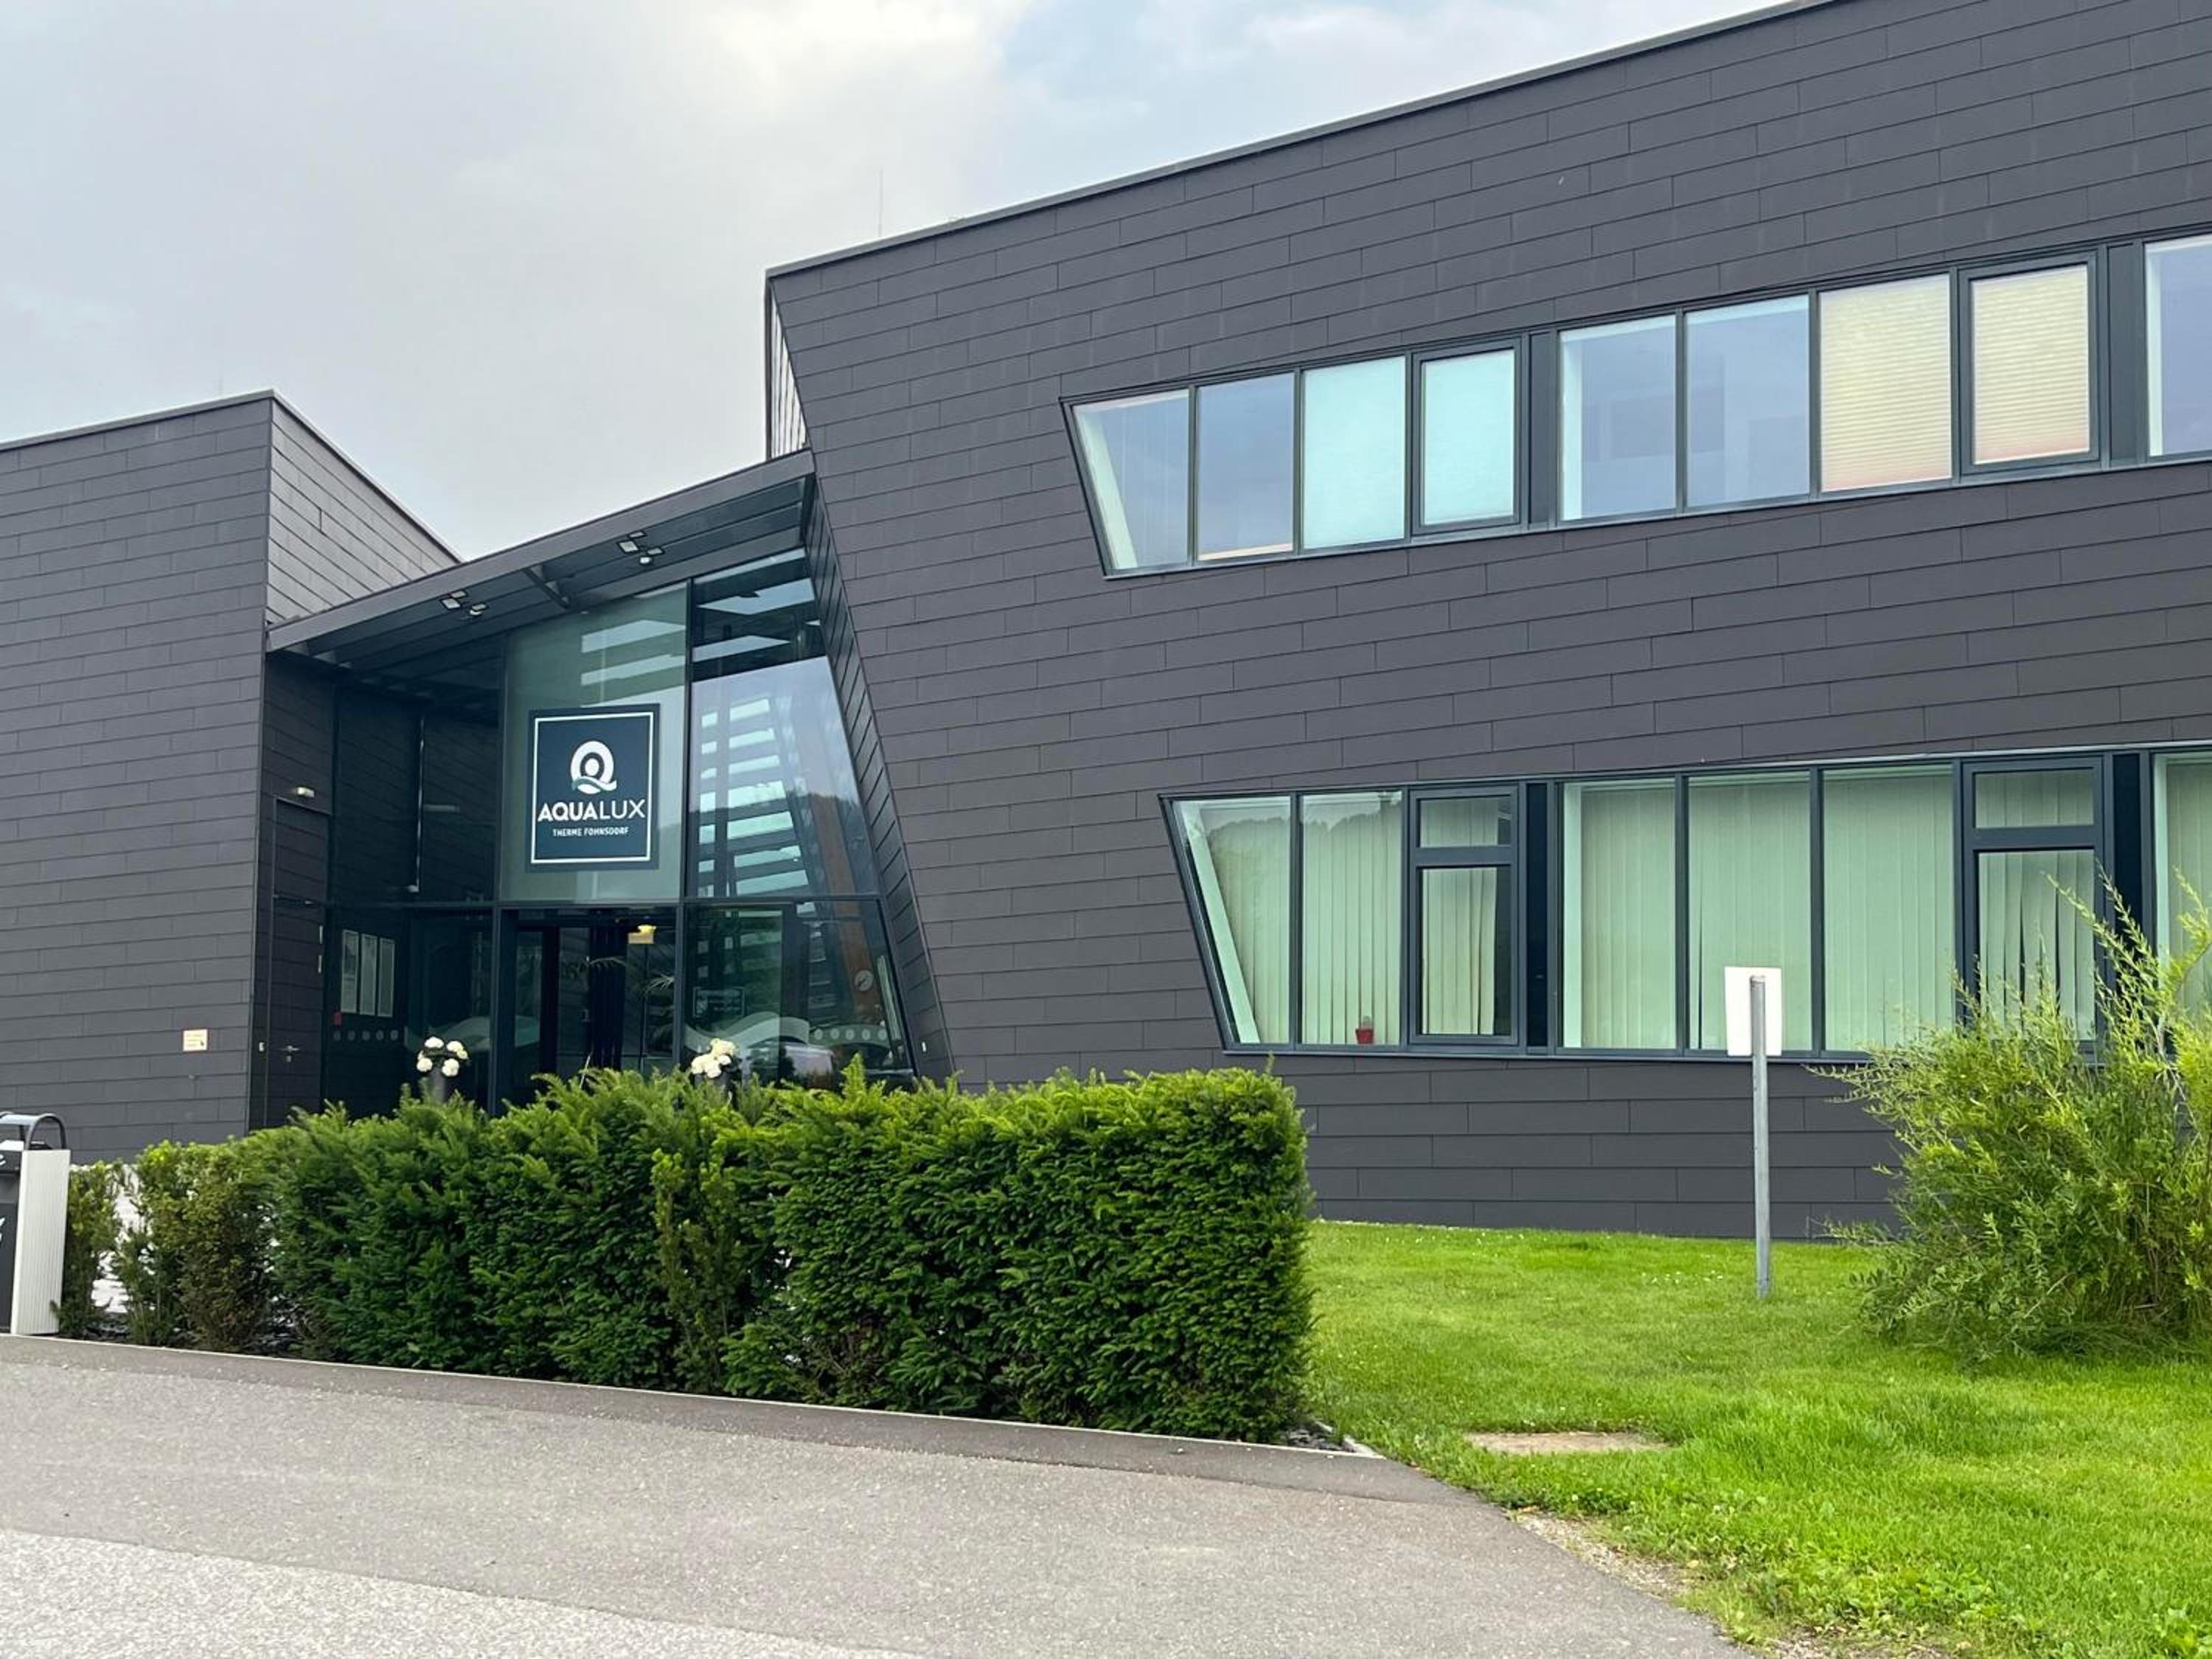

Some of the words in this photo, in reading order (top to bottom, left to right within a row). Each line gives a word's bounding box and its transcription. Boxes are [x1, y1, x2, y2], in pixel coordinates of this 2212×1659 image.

[538, 799, 645, 822] AQUALUX
[552, 828, 582, 837] THERME
[583, 827, 629, 836] FOHNSDORF
